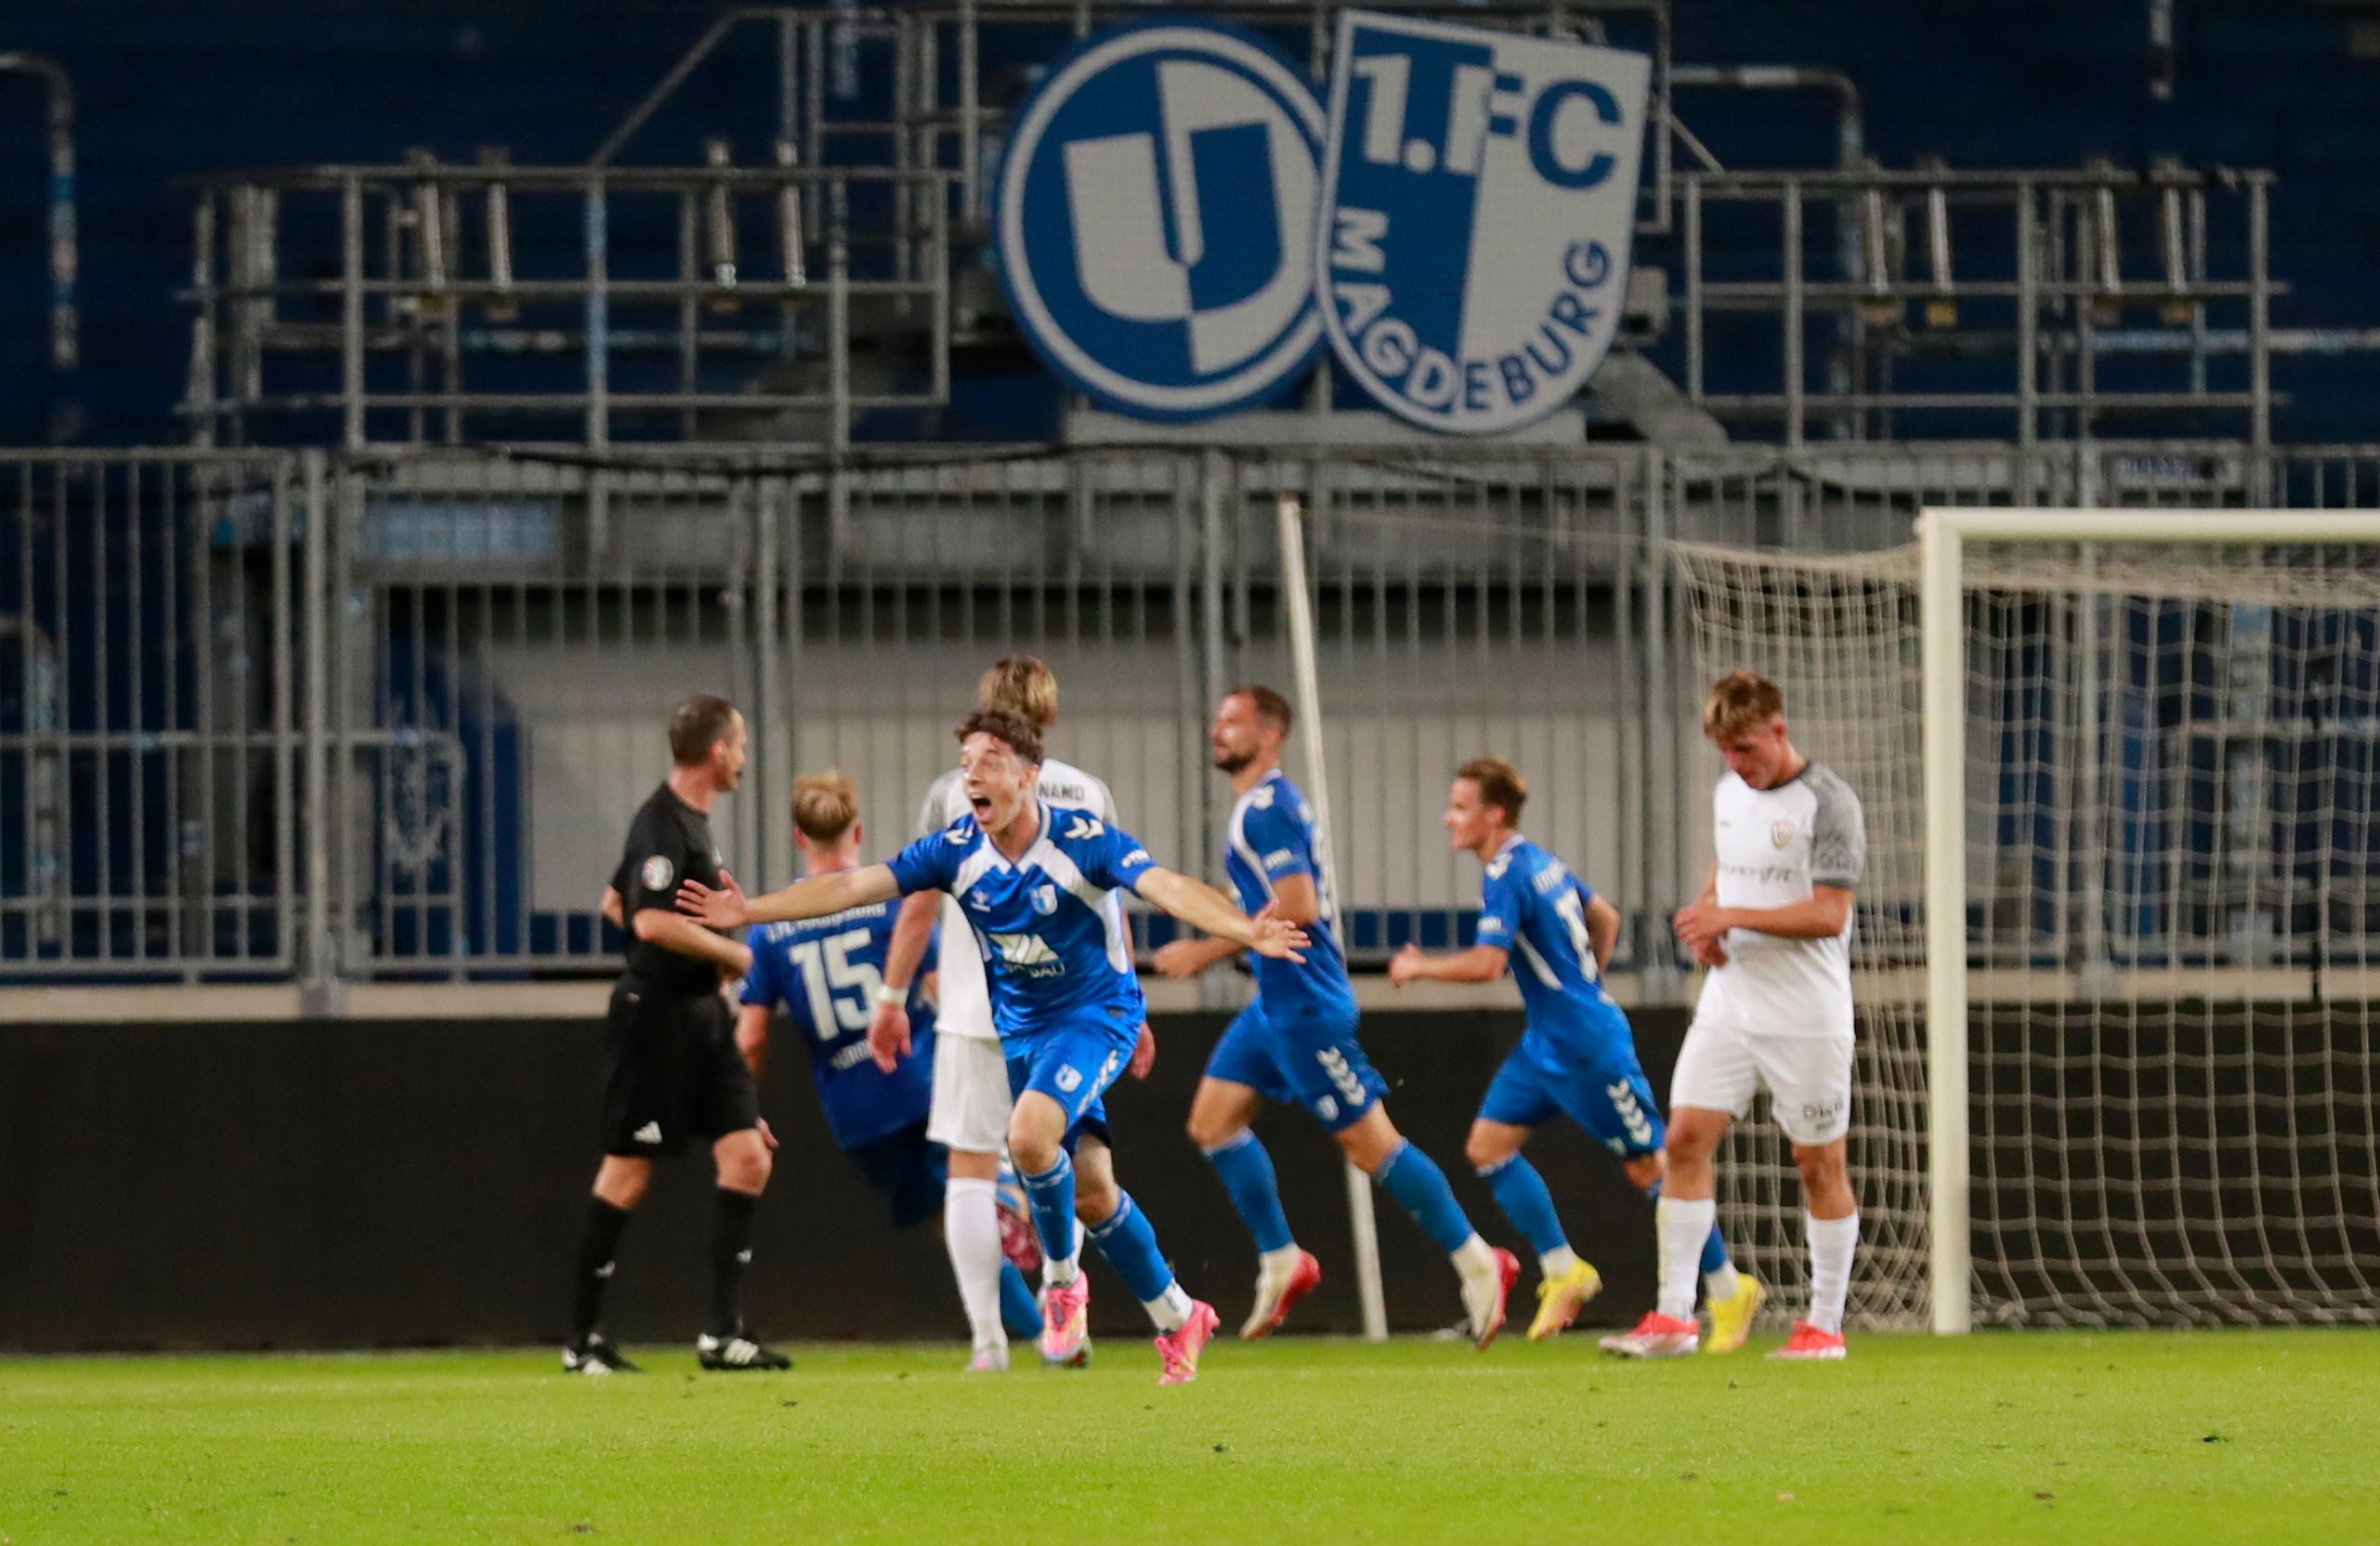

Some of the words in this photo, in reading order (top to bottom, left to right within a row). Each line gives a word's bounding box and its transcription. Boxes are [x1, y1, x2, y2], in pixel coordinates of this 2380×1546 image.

[1353, 53, 1436, 174] 1.
[1443, 63, 1623, 191] FC
[1332, 206, 1612, 413] MAGDEBURG
[1038, 781, 1086, 802] NAMO
[790, 927, 883, 1042] 15
